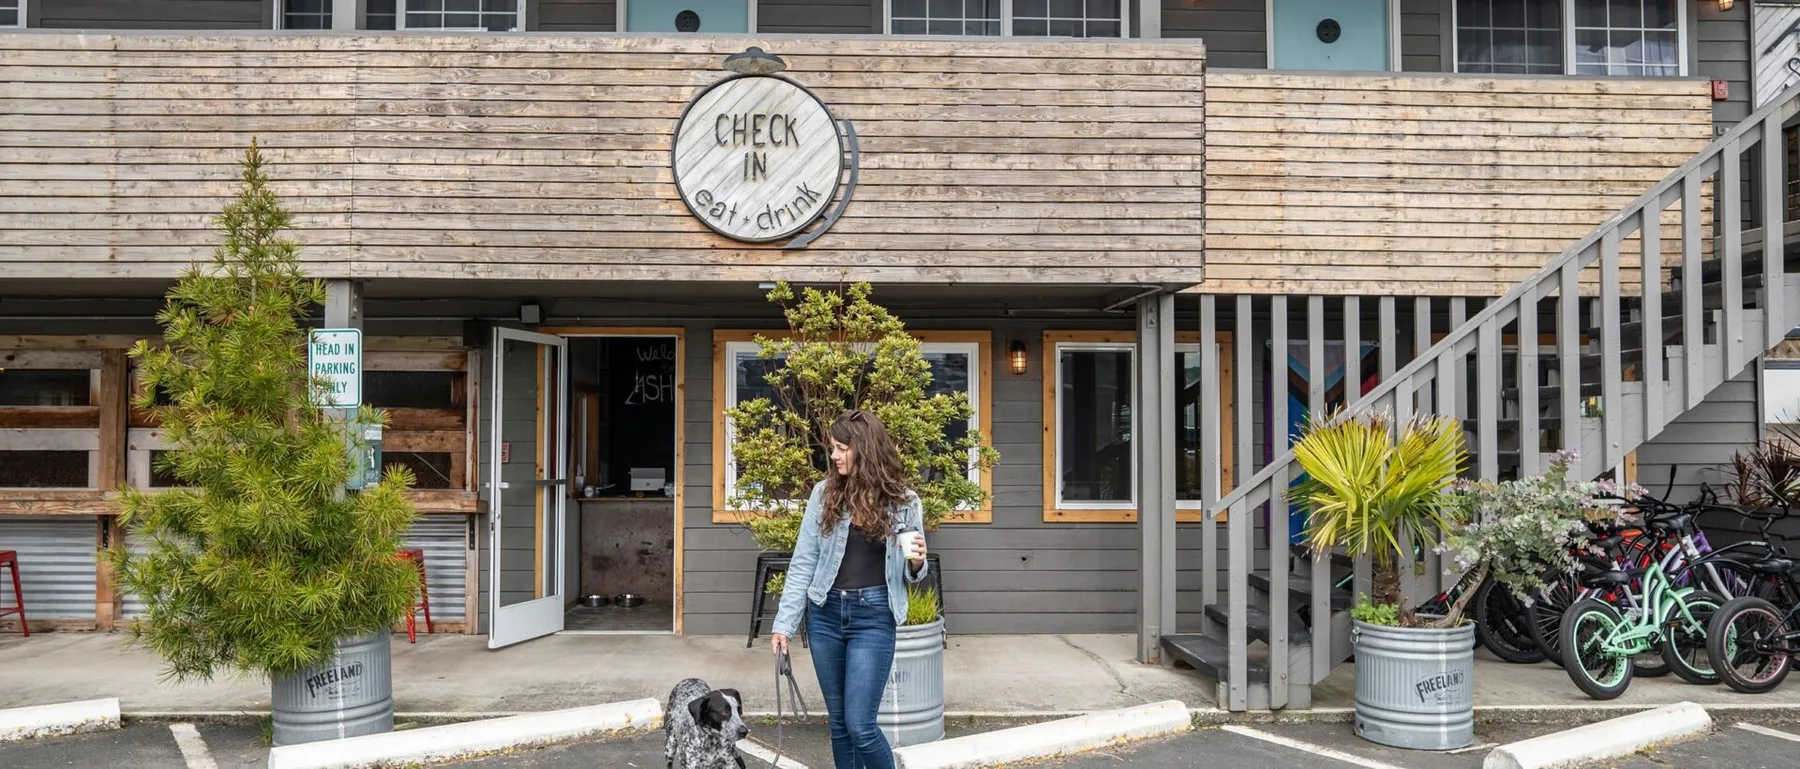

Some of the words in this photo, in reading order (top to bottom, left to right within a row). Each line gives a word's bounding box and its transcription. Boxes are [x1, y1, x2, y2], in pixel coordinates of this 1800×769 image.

[714, 112, 800, 147] CHECK
[743, 151, 767, 181] IN
[694, 188, 738, 226] eat
[756, 180, 823, 230] drink
[315, 343, 340, 355] HEAD
[345, 343, 354, 355] IN
[637, 344, 675, 361] Welc
[315, 362, 355, 374] PARKING
[323, 381, 347, 393] NLY
[307, 664, 363, 698] FREELAND
[1416, 672, 1464, 703] FREELAND
